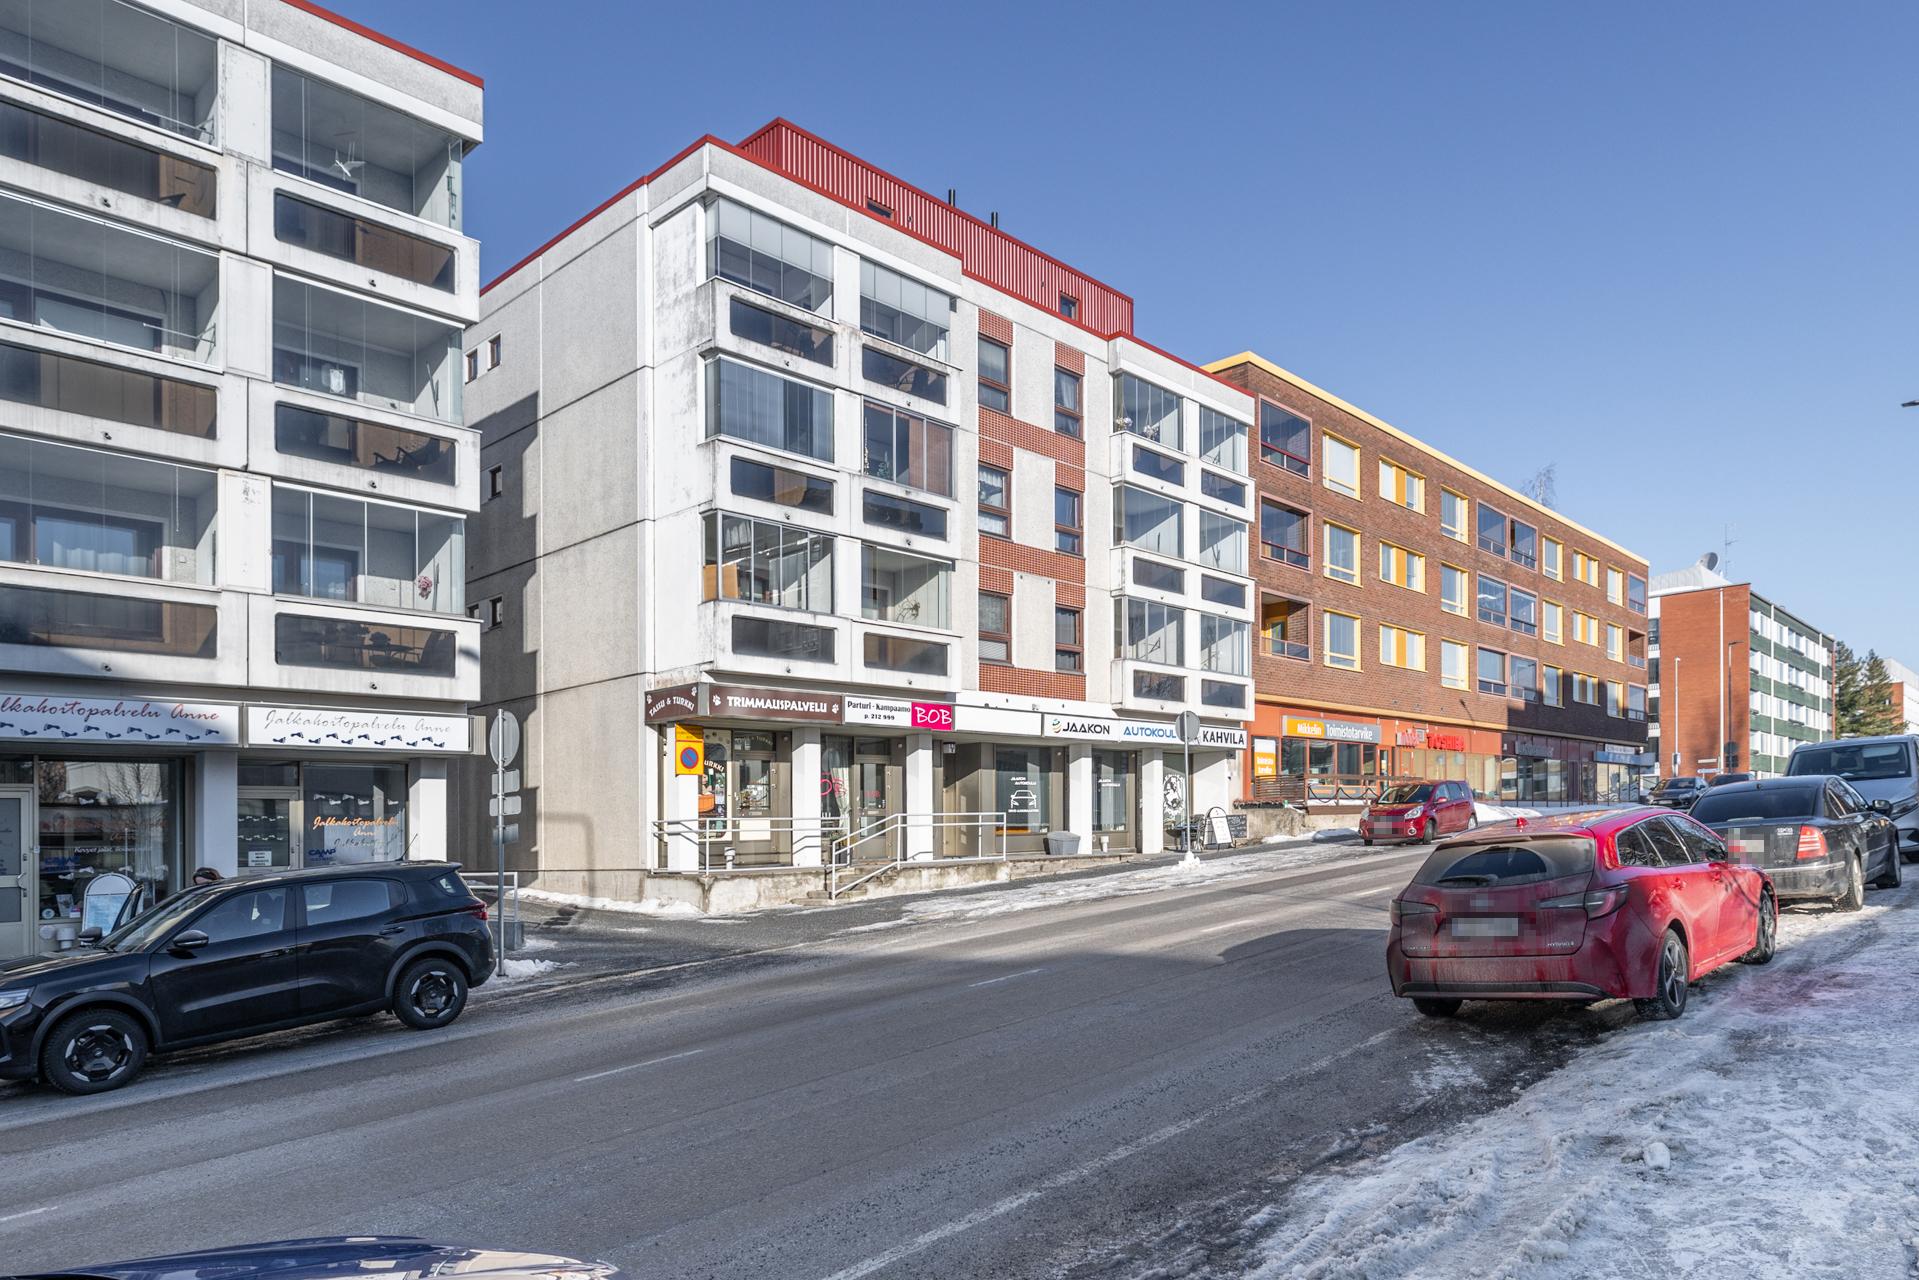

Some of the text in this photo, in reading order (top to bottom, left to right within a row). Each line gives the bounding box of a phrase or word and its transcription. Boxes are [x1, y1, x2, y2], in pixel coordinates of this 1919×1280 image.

[0, 697, 220, 722] lkahoitopalvelu Anne
[672, 696, 695, 711] TURKKI
[727, 696, 827, 713] TRIMMAUSPALVELU
[847, 701, 872, 710] Parturi
[876, 703, 911, 713] Kampaamo
[264, 709, 450, 733] Jalkahoitopalvelu Anne
[915, 706, 952, 725] BOB
[1062, 721, 1177, 740] JAAKON AUTOKOUL
[1203, 730, 1245, 745] KAHVILA
[1297, 722, 1373, 740] Mikkelin Toimistotarvike
[704, 760, 724, 773] URKKI
